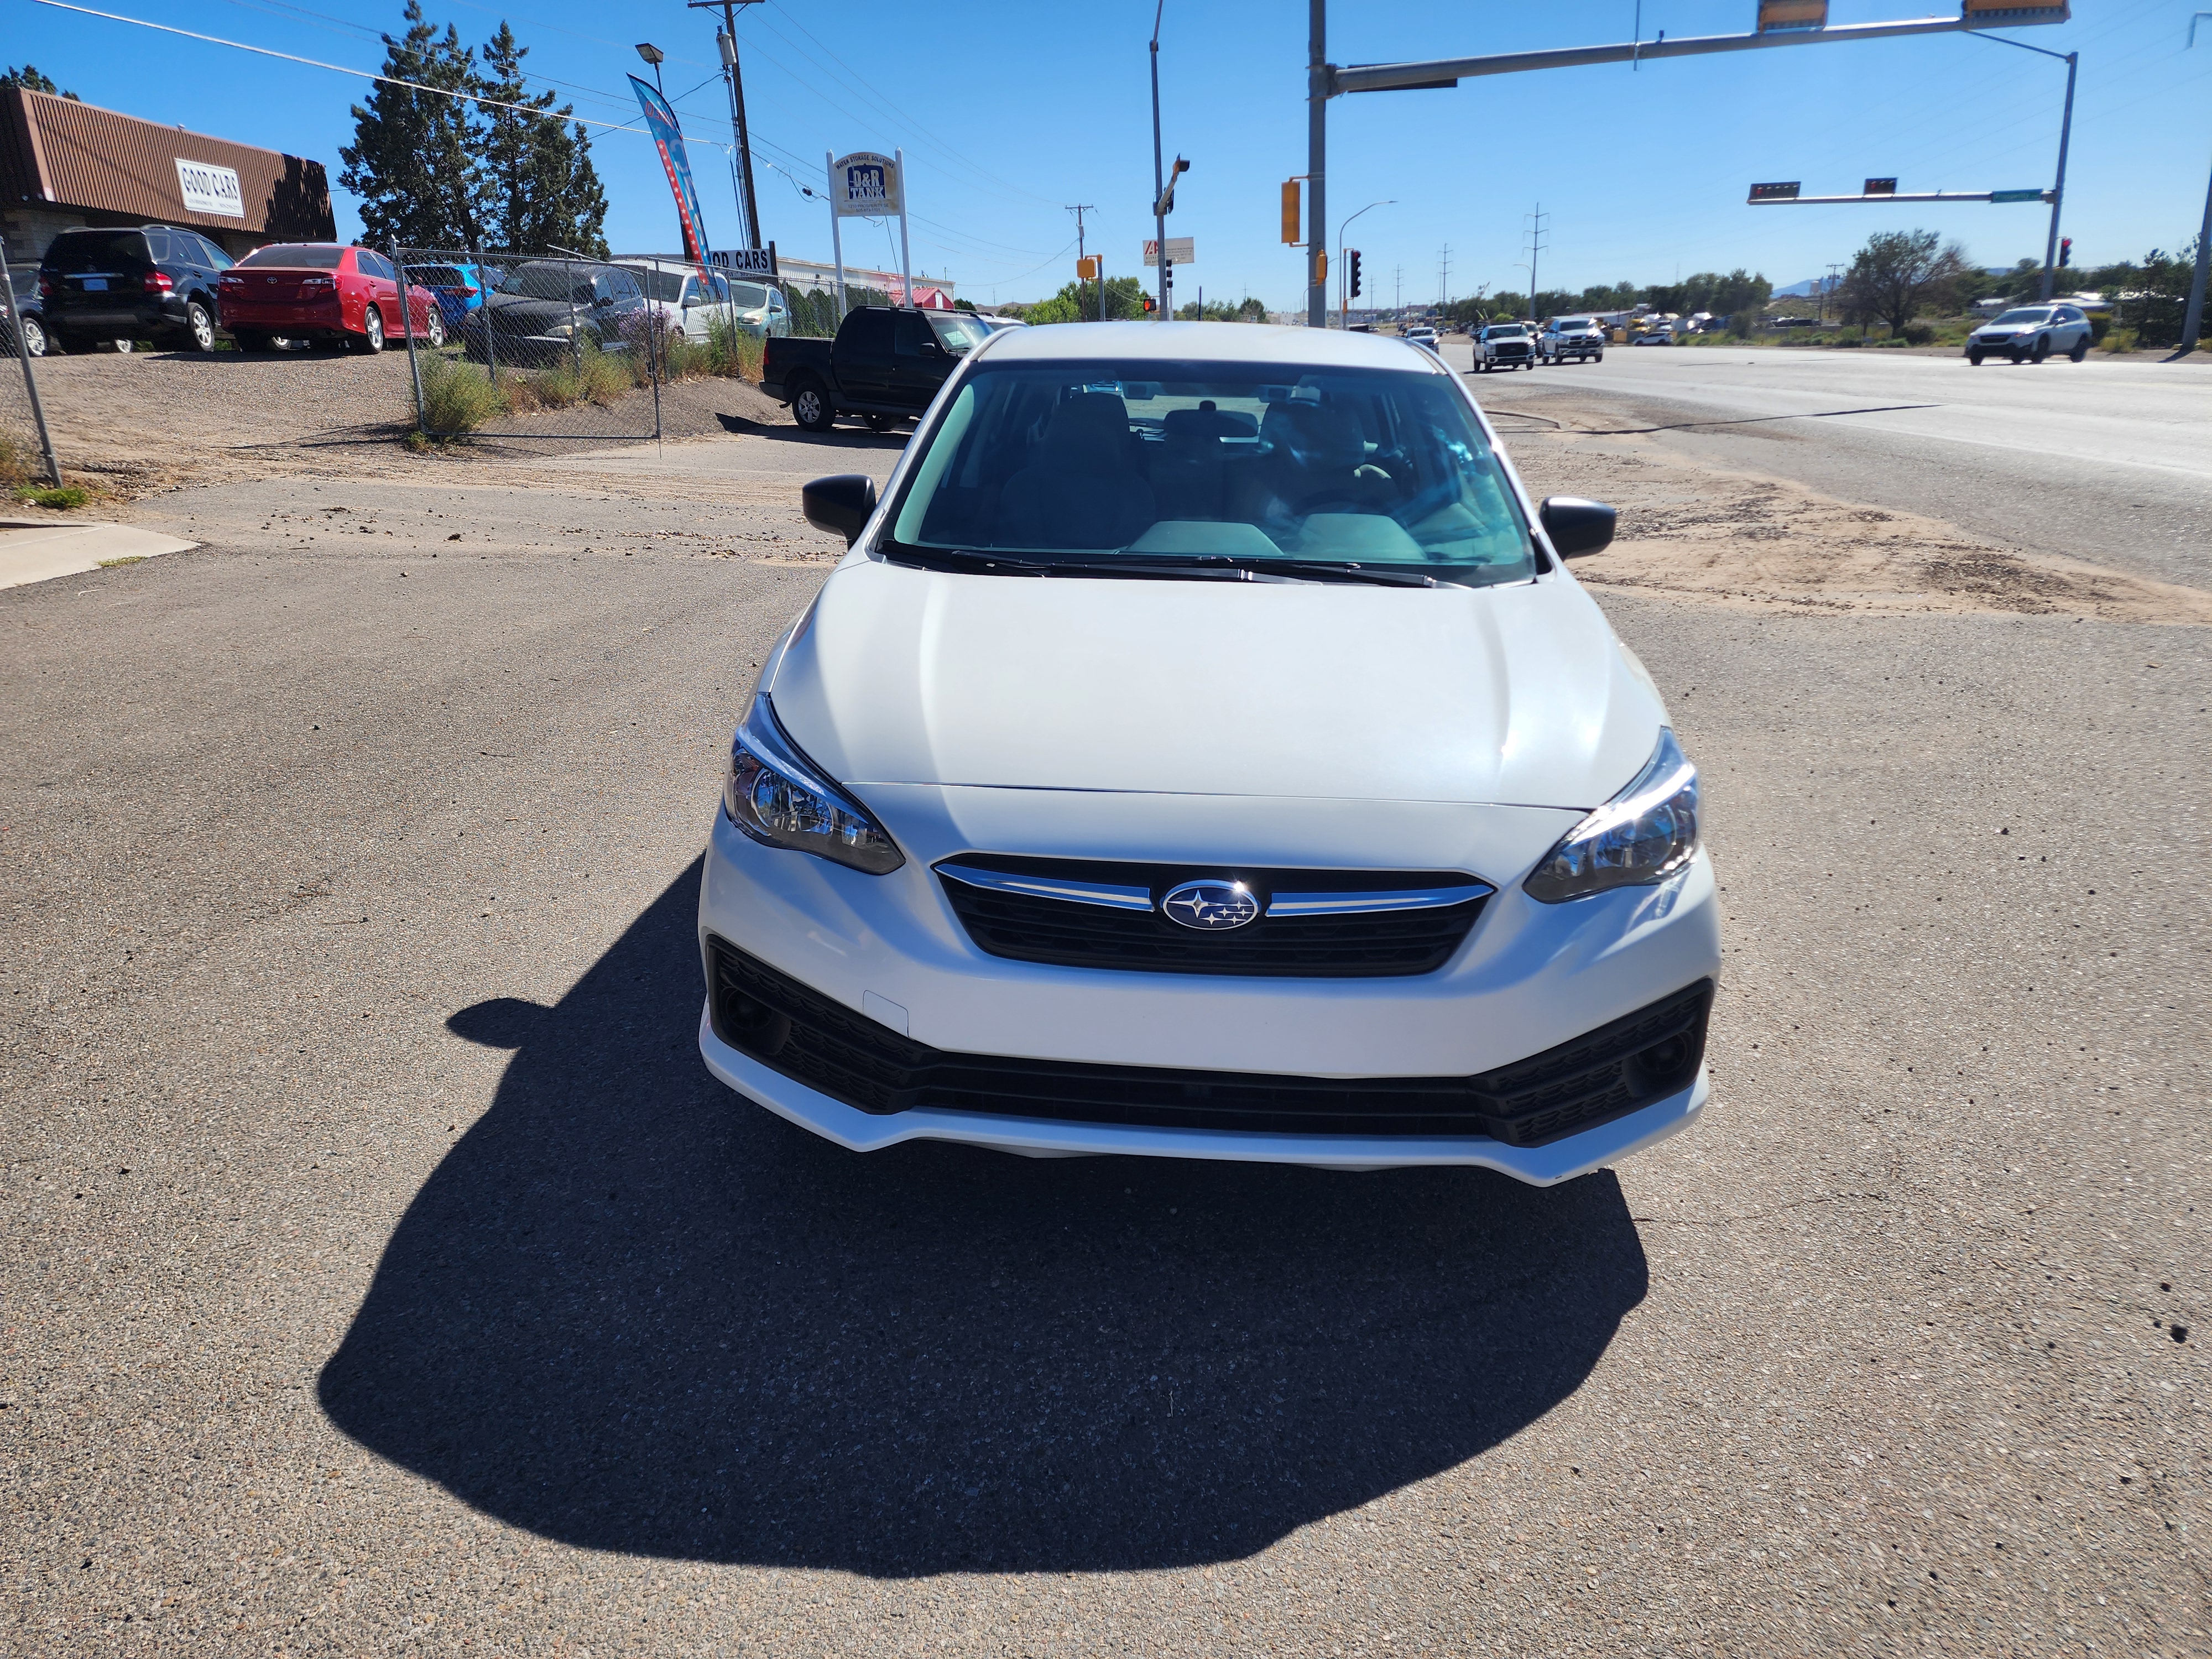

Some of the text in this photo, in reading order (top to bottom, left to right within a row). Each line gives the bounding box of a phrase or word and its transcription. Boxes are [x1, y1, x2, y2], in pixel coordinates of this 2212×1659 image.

[836, 158, 849, 170] WATER
[872, 155, 894, 169] SOLUTIONS
[182, 166, 238, 200] GOOD CARS
[853, 169, 880, 186] D&R
[851, 187, 884, 199] TANK
[712, 251, 768, 270] OD CARS
